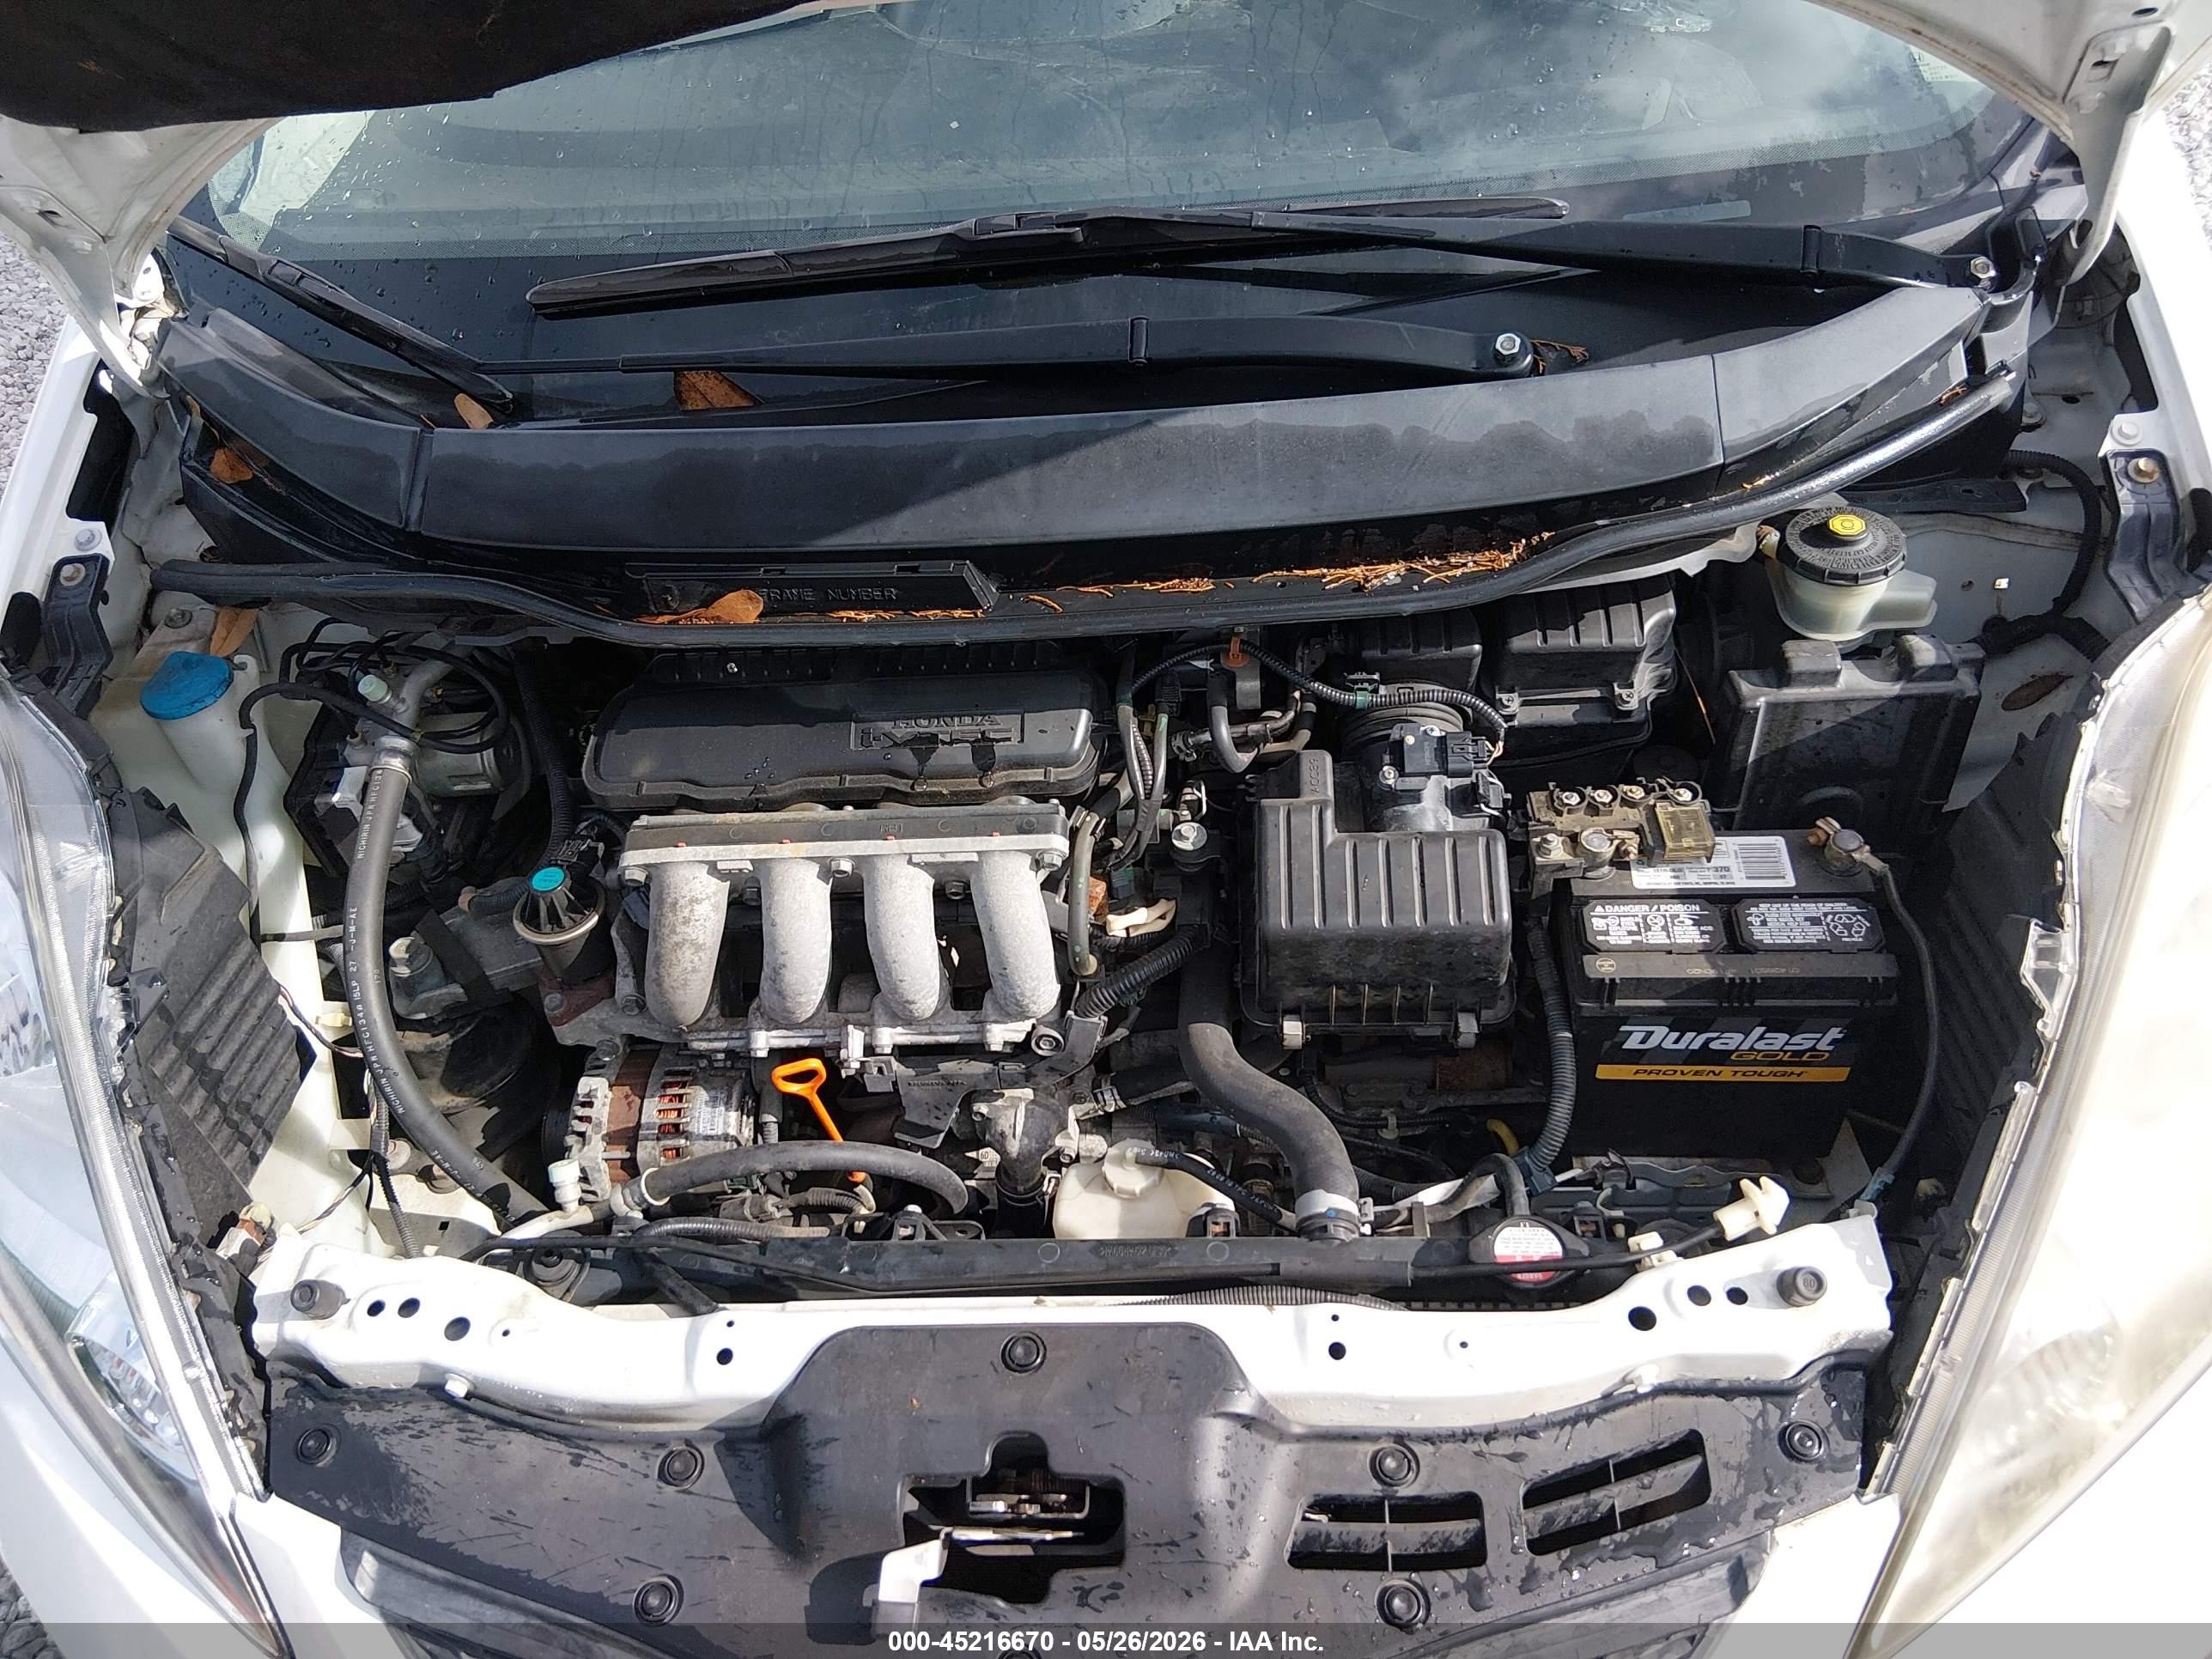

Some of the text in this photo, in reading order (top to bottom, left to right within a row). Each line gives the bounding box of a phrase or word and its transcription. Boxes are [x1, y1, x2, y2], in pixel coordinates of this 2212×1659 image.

[827, 587, 899, 601] NUMBER
[892, 714, 1001, 730] HONDA
[349, 961, 357, 972] 27
[1618, 1025, 1845, 1050] Duralast
[1730, 1051, 1830, 1061] GOLD
[1633, 1068, 1723, 1077] PROVEN
[380, 1078, 405, 1114] NICHIRIN
